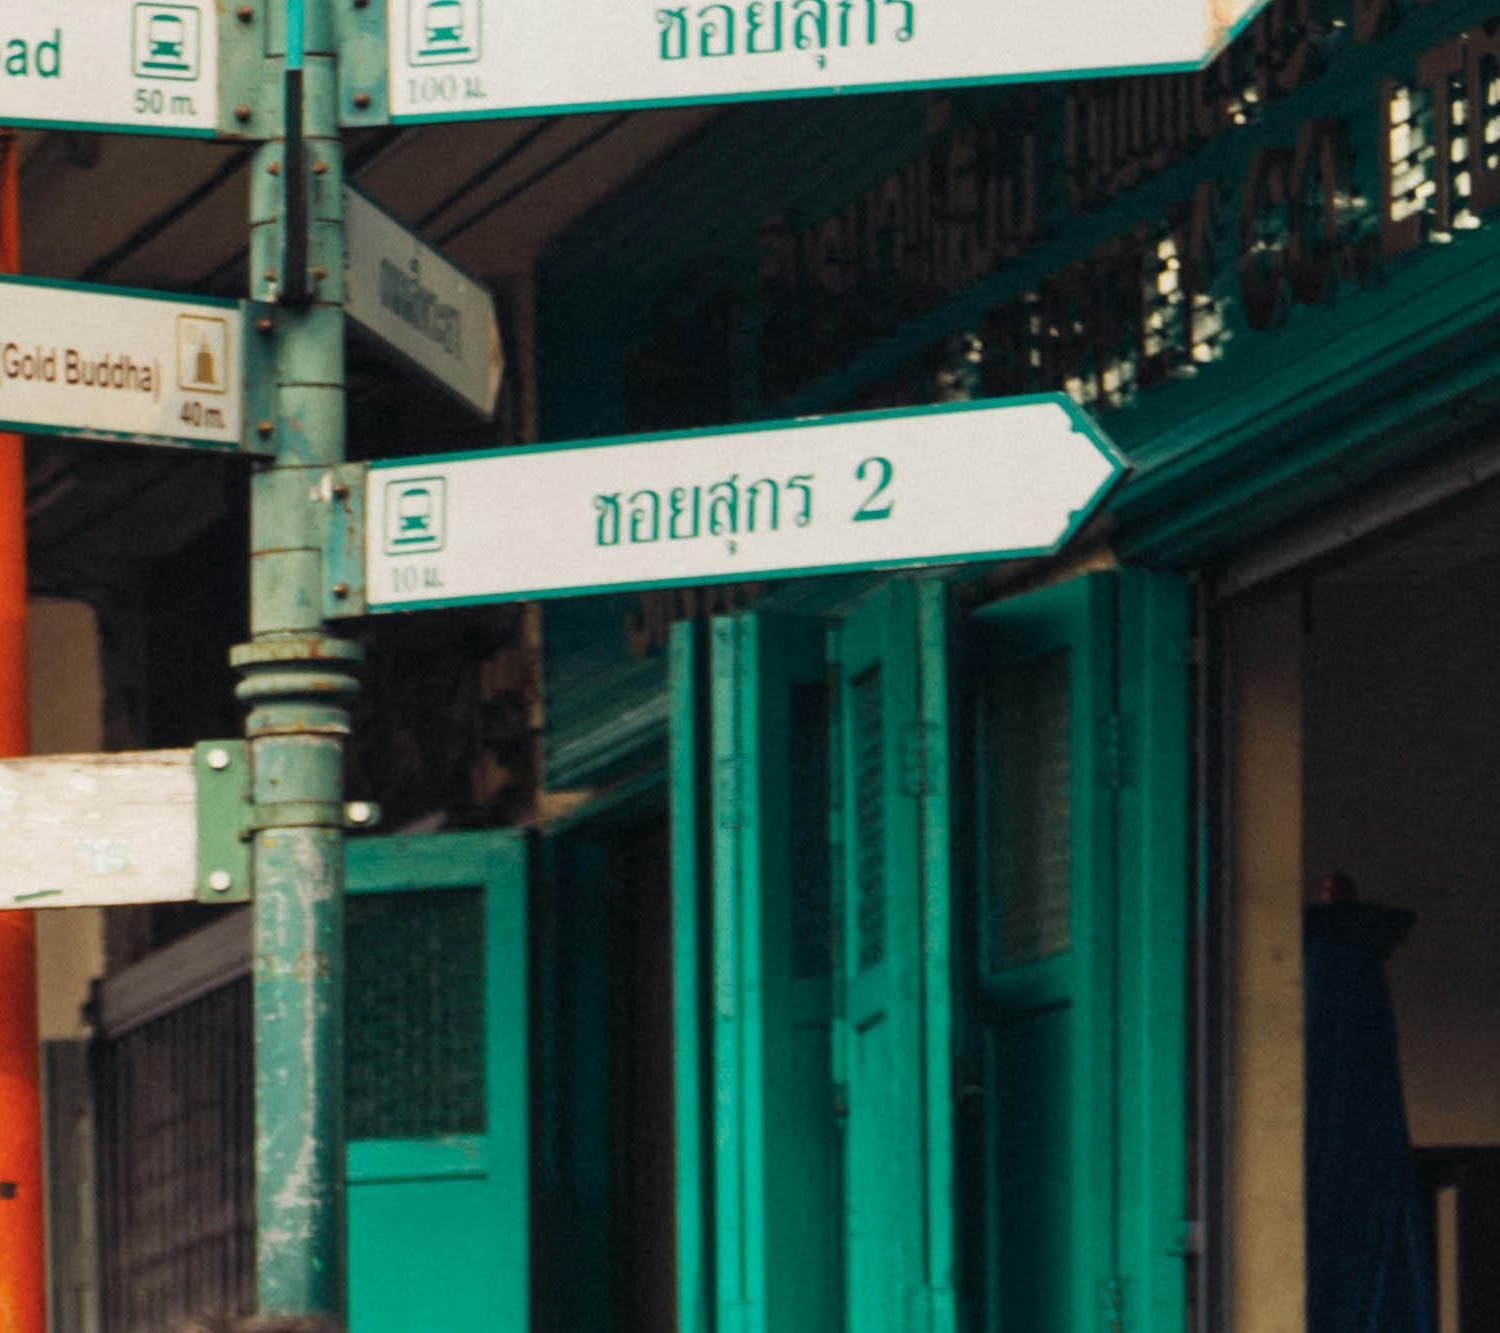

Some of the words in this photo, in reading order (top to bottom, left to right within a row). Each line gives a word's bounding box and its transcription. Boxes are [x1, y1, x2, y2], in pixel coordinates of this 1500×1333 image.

[134, 88, 163, 115] 50
[170, 94, 198, 116] m.
[406, 75, 459, 104] 100
[65, 348, 161, 403] Buddha)
[180, 401, 202, 428] 40
[594, 473, 816, 556] ซอยสุกร
[851, 456, 895, 523] 2
[390, 566, 418, 594] 10
